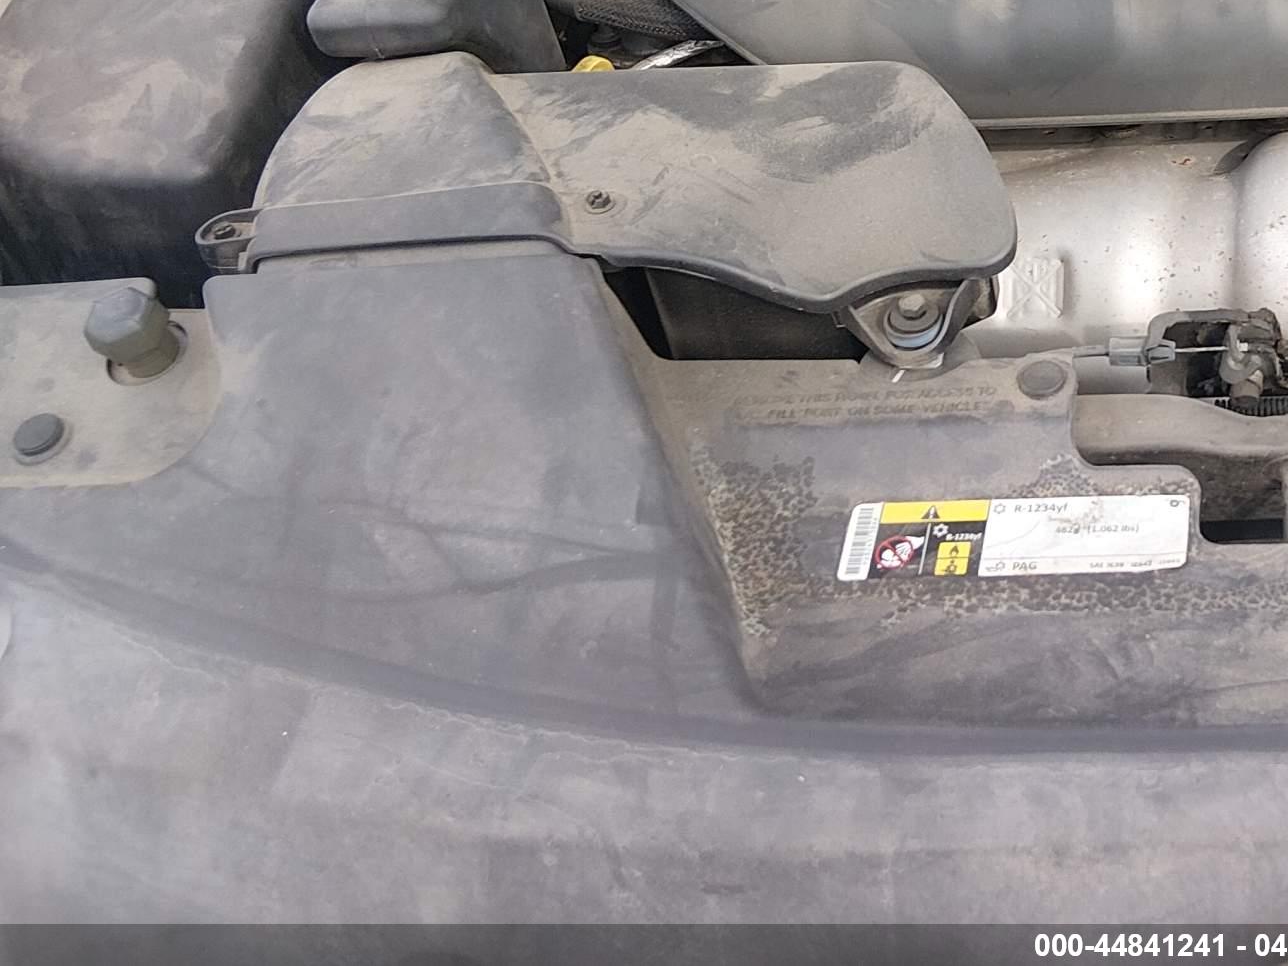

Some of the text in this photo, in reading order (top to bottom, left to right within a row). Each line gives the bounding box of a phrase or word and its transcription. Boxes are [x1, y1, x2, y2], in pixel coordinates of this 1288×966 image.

[976, 385, 997, 396] TO
[1014, 502, 1068, 515] R-1234yf
[1012, 561, 1038, 571] PAG
